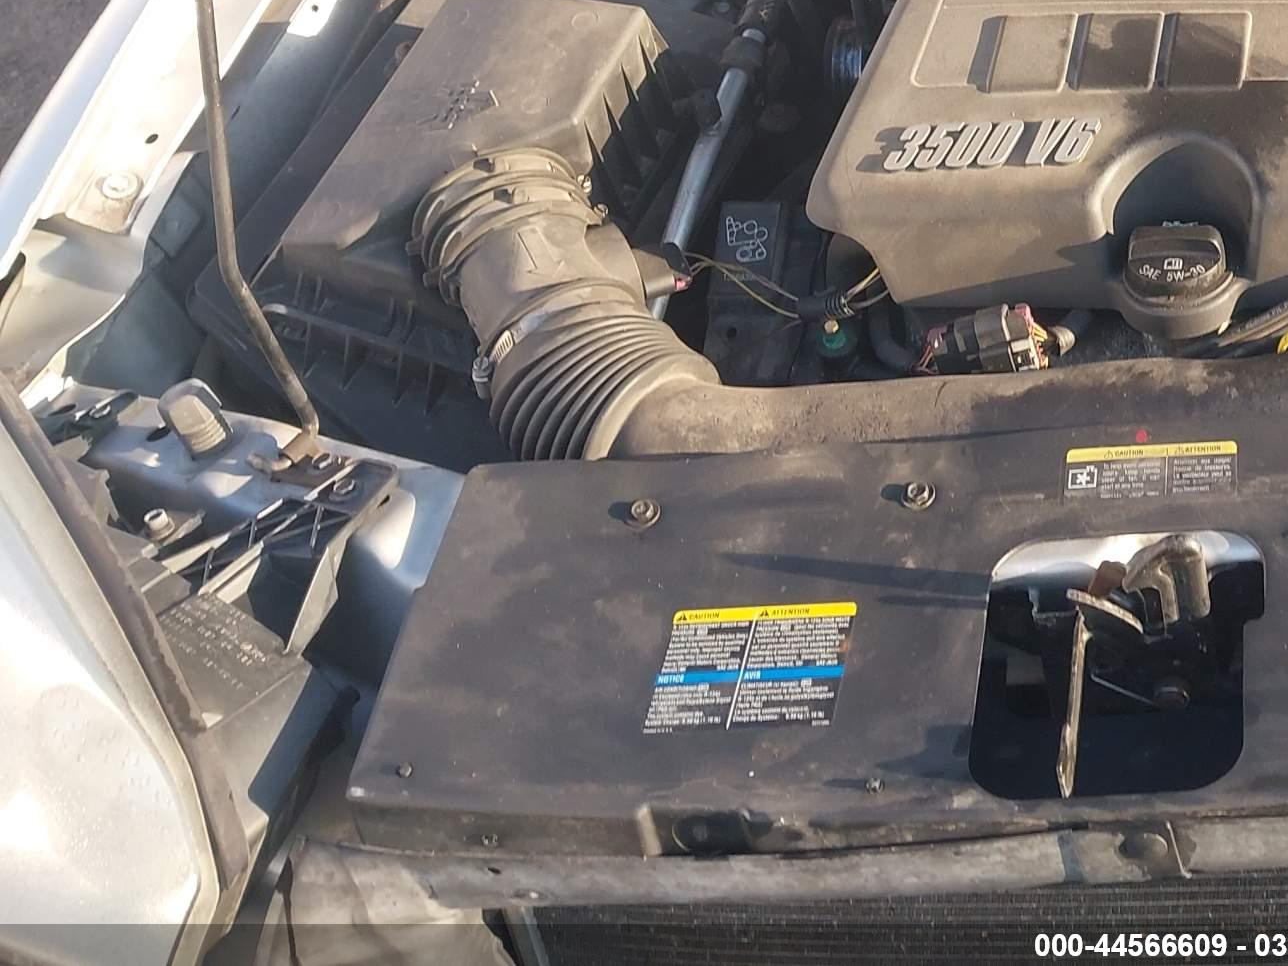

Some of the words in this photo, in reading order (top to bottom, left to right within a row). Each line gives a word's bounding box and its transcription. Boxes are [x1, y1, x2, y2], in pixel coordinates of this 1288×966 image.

[883, 120, 1024, 172] 3500
[1025, 117, 1102, 168] V6
[1138, 263, 1162, 281] SAE
[1166, 263, 1206, 283] 5W-30
